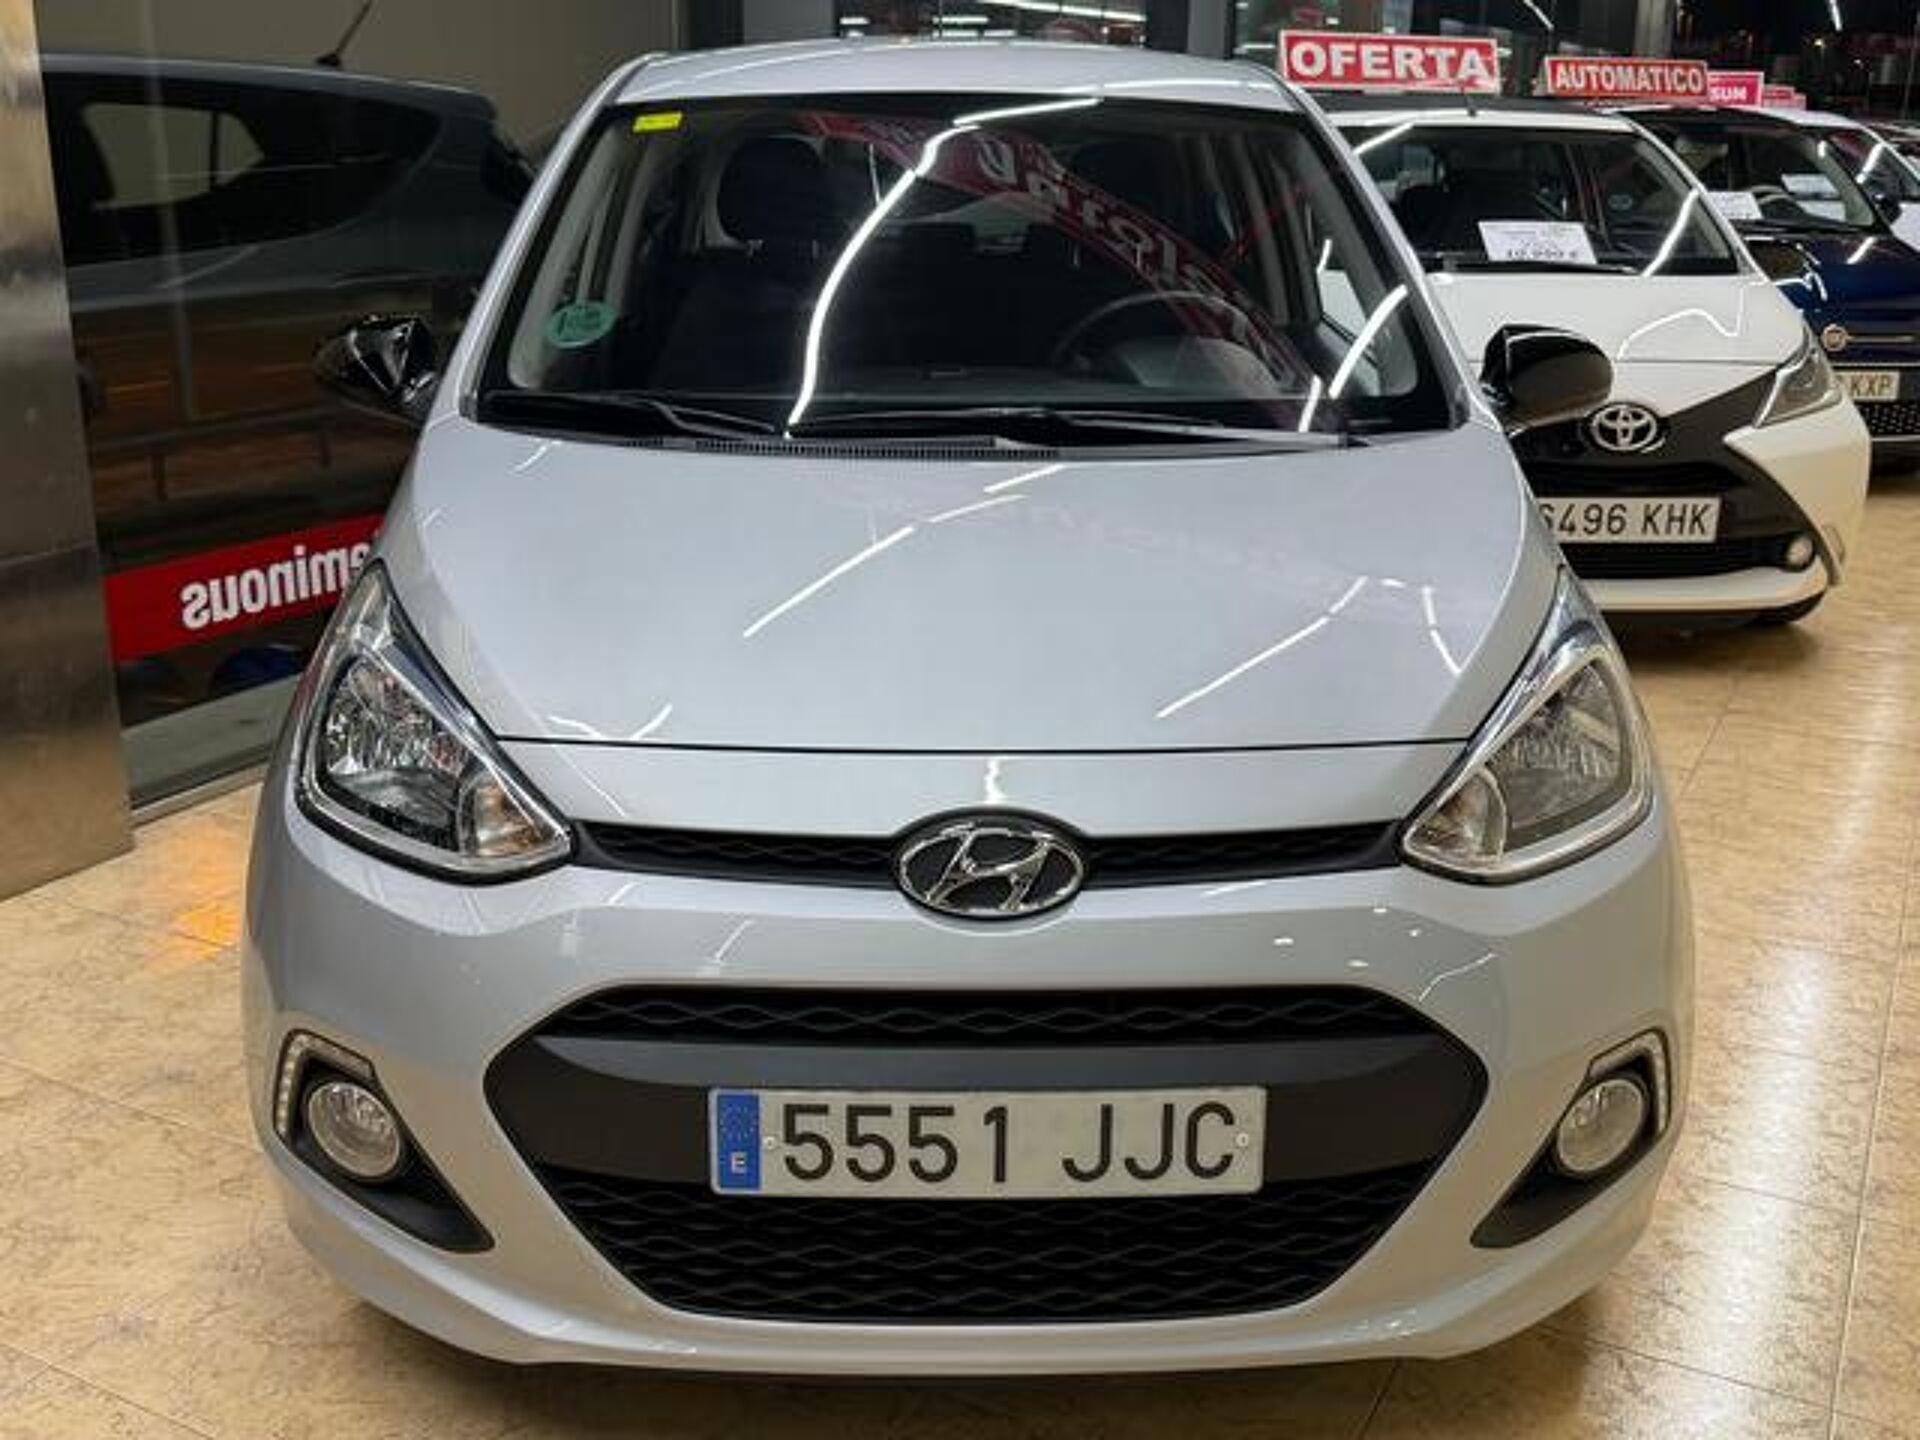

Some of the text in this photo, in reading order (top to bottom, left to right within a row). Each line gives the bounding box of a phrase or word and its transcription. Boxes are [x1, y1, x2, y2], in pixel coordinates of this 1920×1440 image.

[1289, 41, 1490, 81] OFERTA
[1554, 62, 1704, 93] AUTOMATICO
[1642, 503, 1711, 536] KHK
[783, 1103, 1010, 1184] 5551
[1062, 1102, 1235, 1182] JJC
